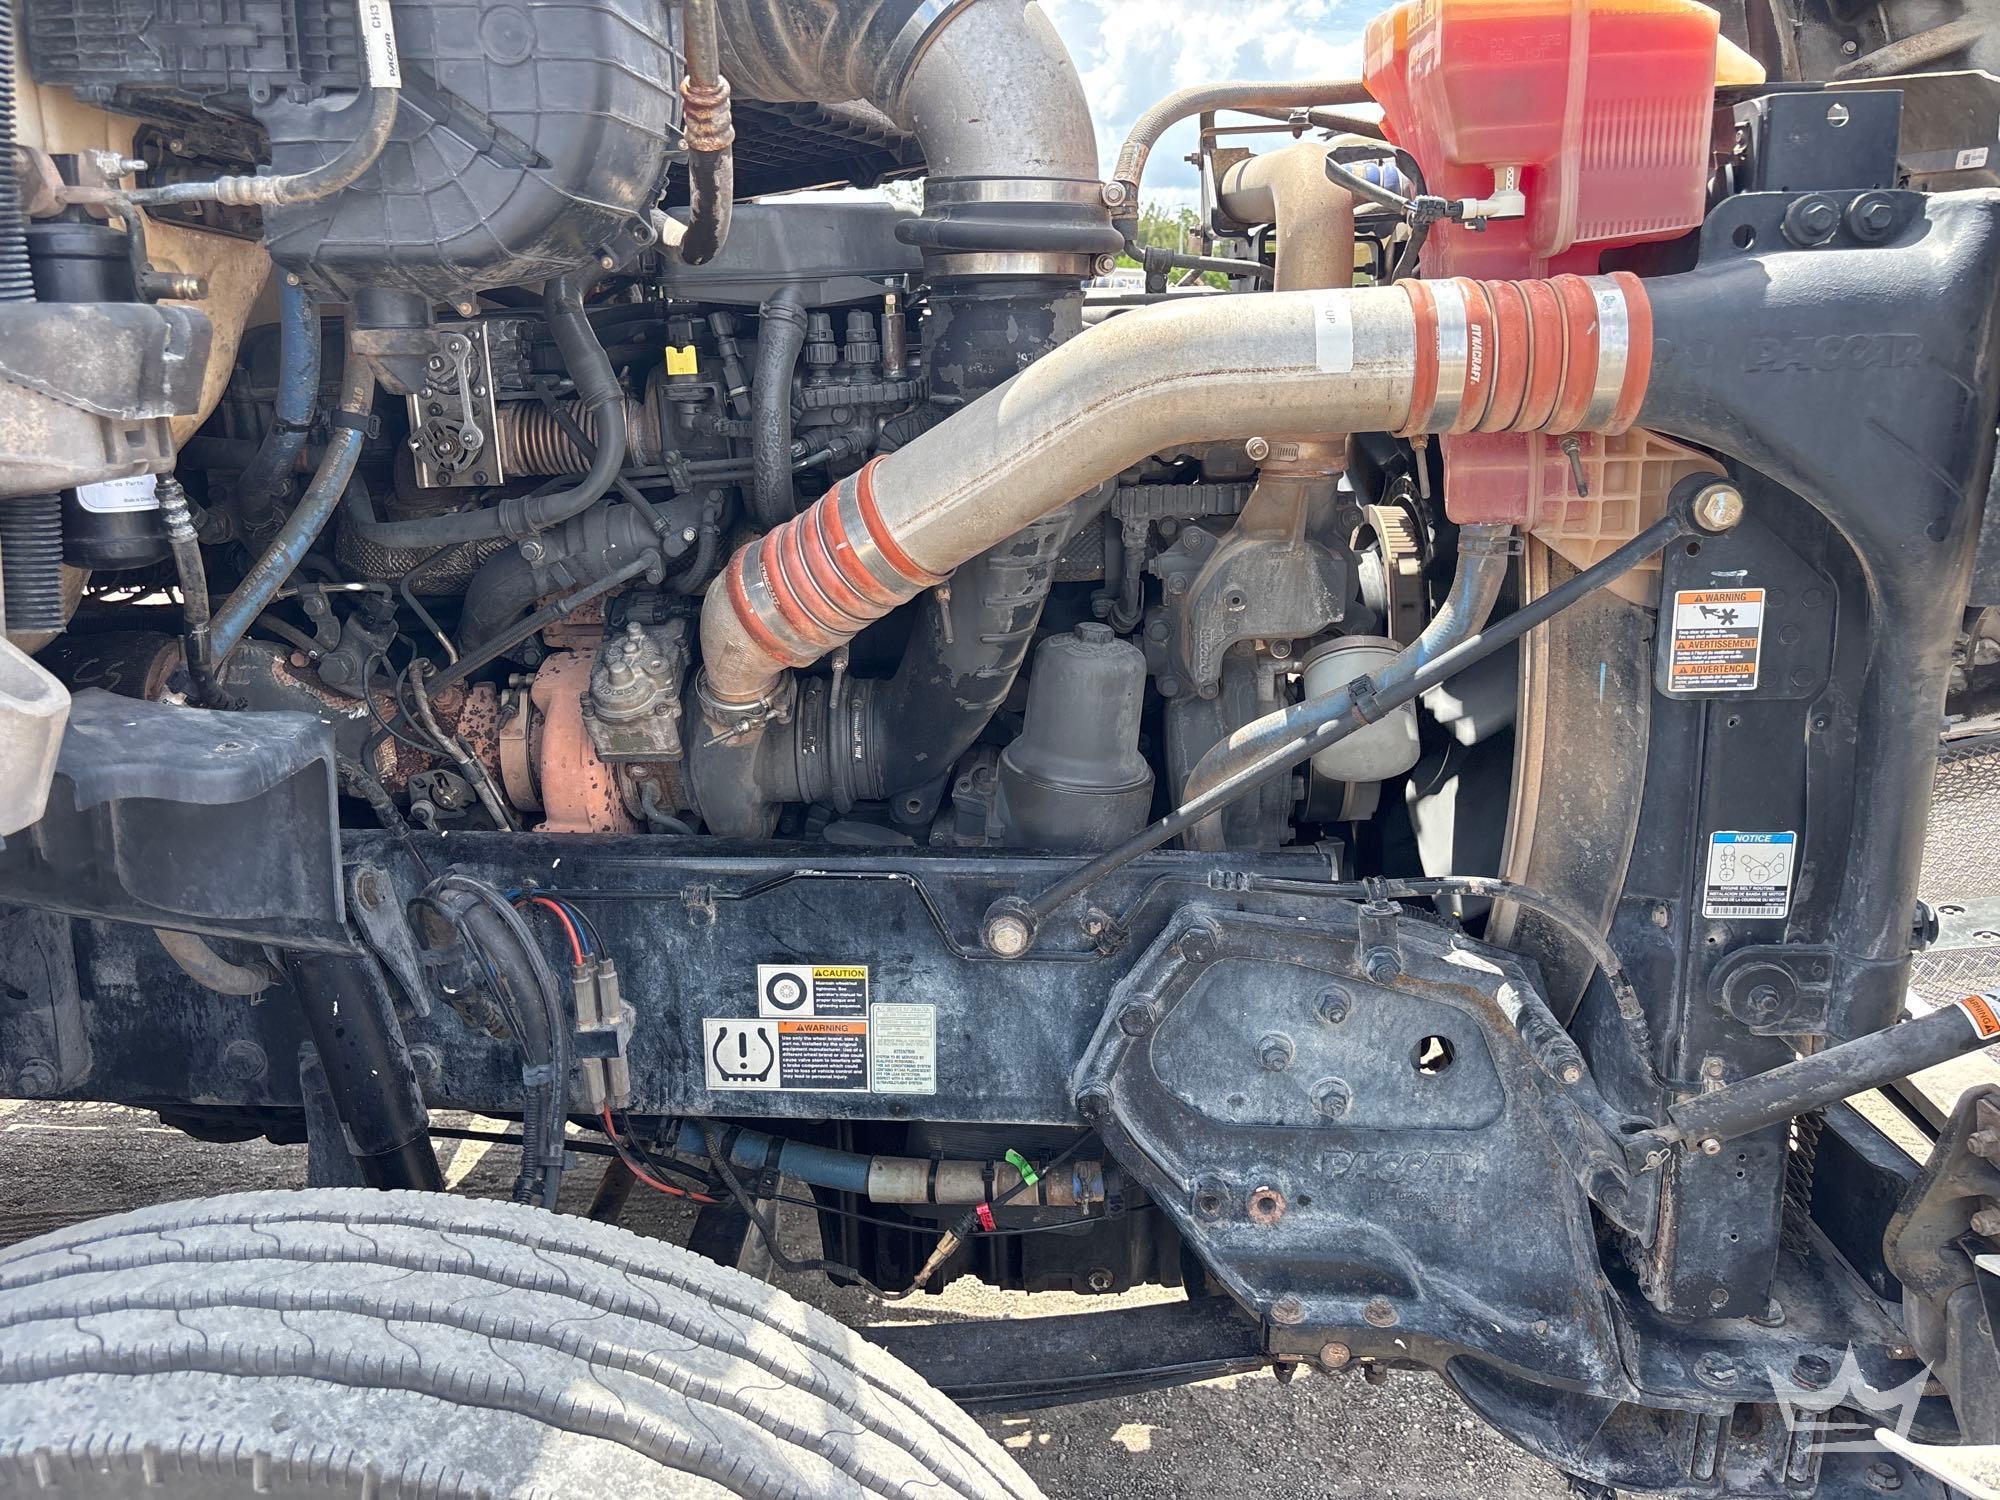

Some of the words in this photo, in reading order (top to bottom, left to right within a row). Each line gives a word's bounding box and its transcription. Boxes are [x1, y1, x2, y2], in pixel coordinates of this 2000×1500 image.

[385, 33, 395, 76] PACCAR
[1325, 310, 1335, 324] UP
[1471, 324, 1482, 382] DYNACRAFT
[1744, 333, 1924, 373] PACCAR
[1706, 593, 1746, 602] WARNING
[1689, 640, 1755, 648] AVERTISSEMENT
[1690, 665, 1749, 673] ADVERTENCIA
[1322, 1151, 1478, 1183] PACCAR
